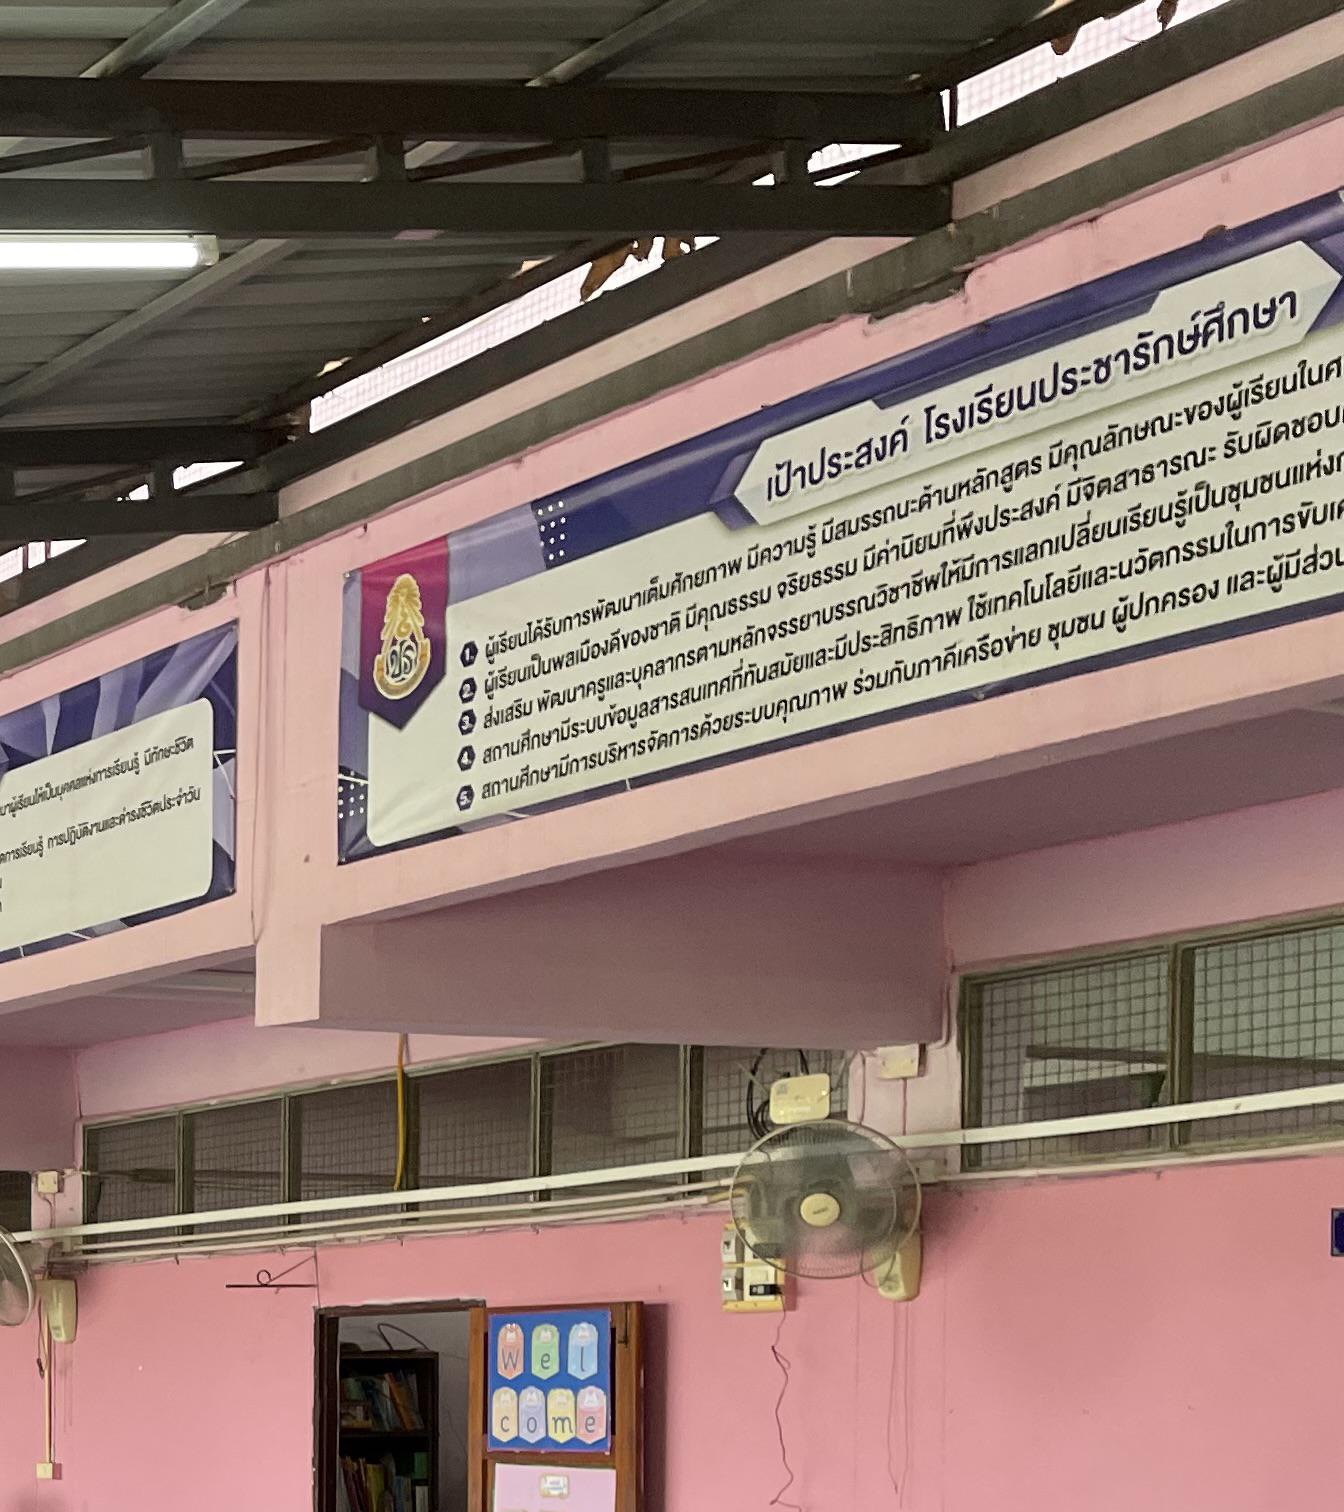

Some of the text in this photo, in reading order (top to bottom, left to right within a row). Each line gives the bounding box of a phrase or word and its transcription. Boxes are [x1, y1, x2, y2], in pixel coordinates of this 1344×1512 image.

[766, 290, 1297, 502] เป้าประสงค์ โรงเรียนประชารักษ์ศึกษา
[484, 610, 681, 701] ผู้เรียนเป็นพลเมืองดีของชาติ
[685, 585, 772, 632] มีคุณธรรม
[776, 557, 858, 600] จริยธรรม
[1066, 446, 1217, 508] มีจิตสาธารณะ
[1223, 404, 1344, 460] รับผิดชอบ
[485, 556, 743, 665] ผู้เรียนได้รับการพัฒนาเต็มศักยภาพ
[746, 523, 818, 571] มีความรู้
[821, 455, 1043, 545] มีสมรรถนะด้านหลักสูตร
[853, 624, 1042, 696] ร่วมกับภาคีเครือข่าย
[1047, 609, 1106, 651] ชุมชน
[1111, 578, 1220, 634] ผู้ปกครอง
[483, 697, 533, 730] ส่งเสริม
